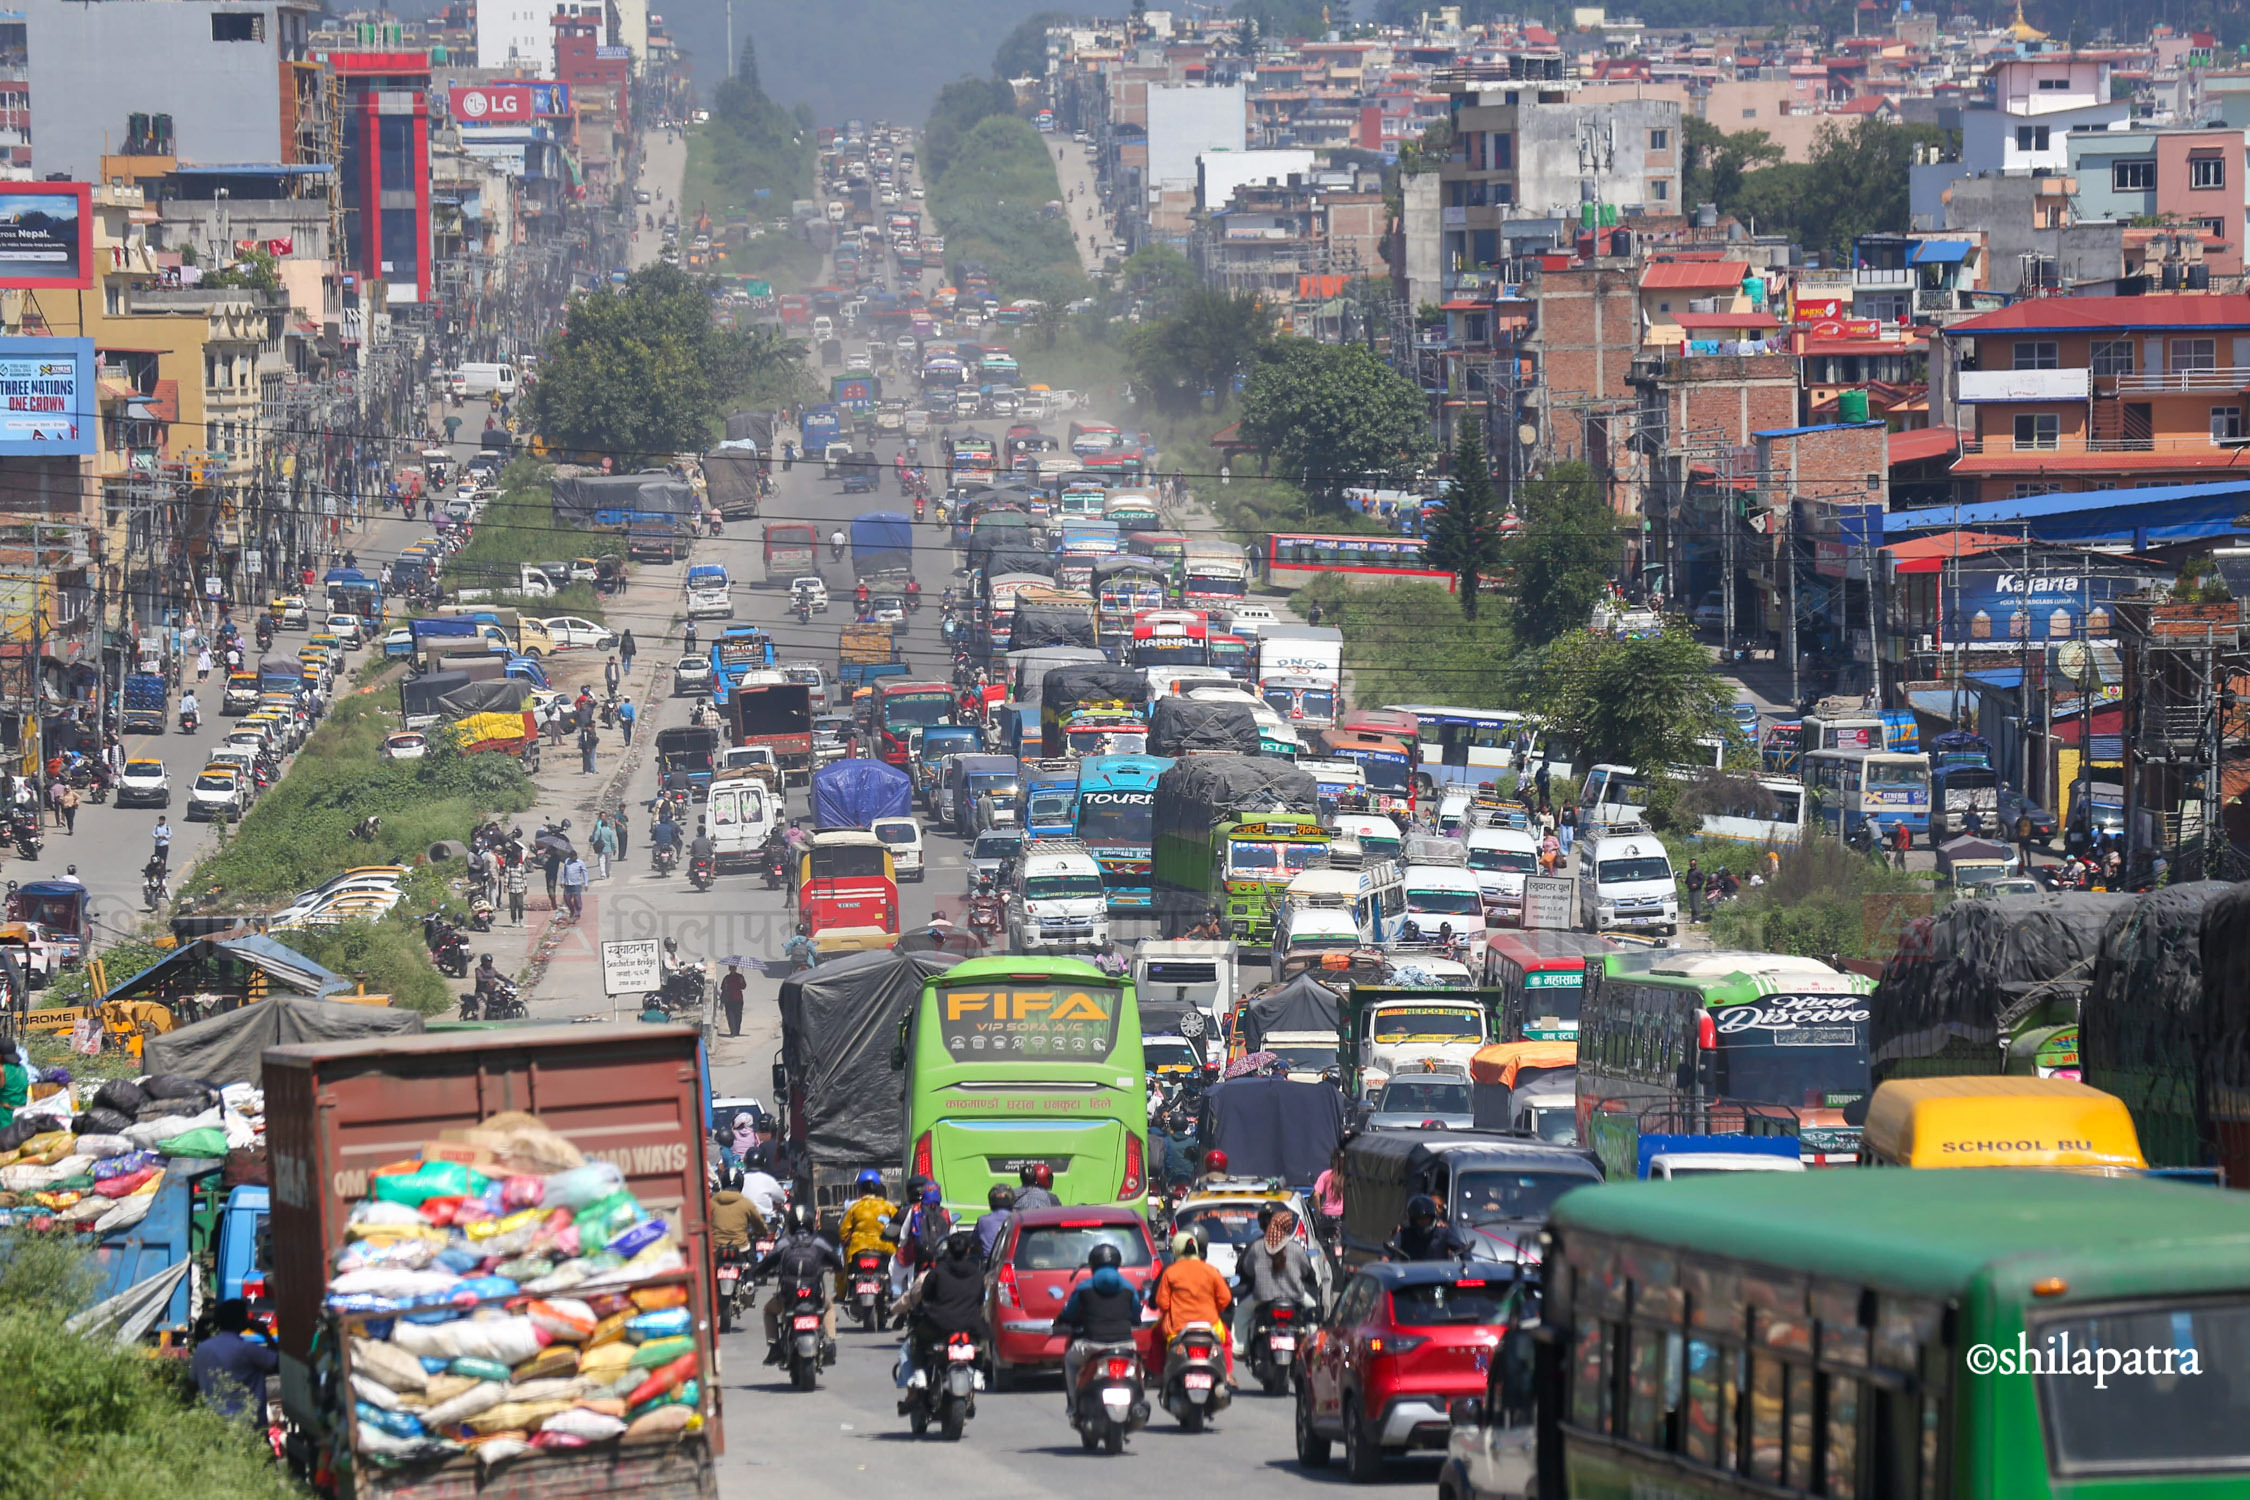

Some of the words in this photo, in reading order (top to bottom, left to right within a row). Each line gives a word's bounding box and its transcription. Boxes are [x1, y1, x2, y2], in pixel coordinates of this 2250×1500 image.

[491, 95, 517, 113] LG
[18, 229, 50, 240] Nepal.
[0, 380, 29, 396] THREE
[31, 380, 74, 396] NATIONS
[9, 396, 28, 411] ONE
[30, 396, 65, 412] CROWN
[1107, 512, 1156, 520] TOURIST
[1995, 574, 2079, 596] Kajaria
[1135, 638, 1204, 648] KARNALI
[1083, 793, 1154, 806] TOURI
[1883, 792, 1909, 800] XTREME
[947, 992, 1110, 1021] FIFA
[1443, 1008, 1473, 1016] NEPAL
[976, 1022, 1004, 1032] VIP
[1006, 1022, 1050, 1032] SOFA
[1053, 1022, 1085, 1032] A/C
[1942, 1140, 2049, 1153] SCHOOL
[633, 1143, 688, 1174] WAYS
